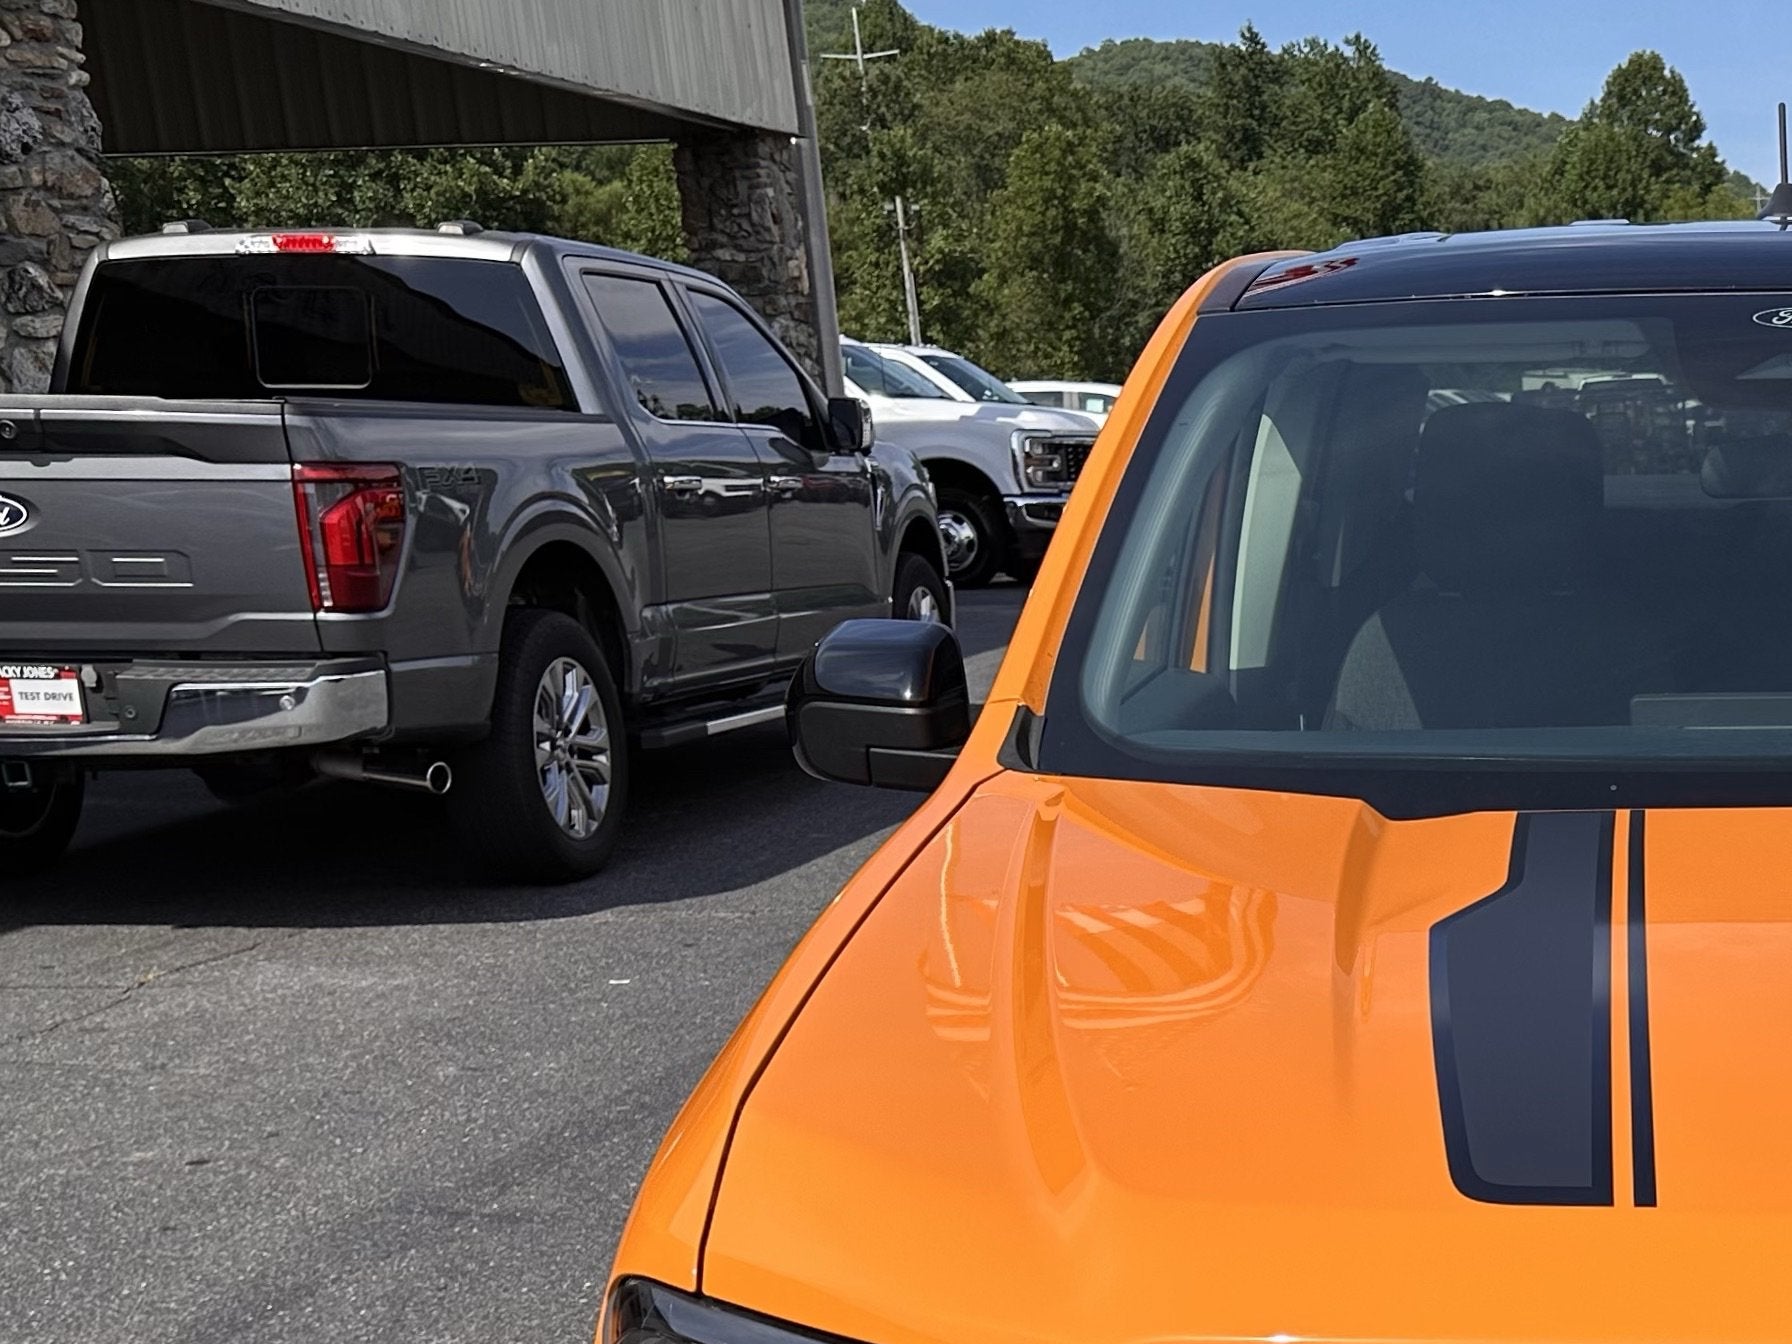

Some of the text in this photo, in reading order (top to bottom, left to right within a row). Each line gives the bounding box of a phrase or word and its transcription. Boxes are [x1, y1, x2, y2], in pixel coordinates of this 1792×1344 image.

[23, 665, 55, 679] JONES
[18, 691, 41, 701] TEST
[44, 691, 74, 702] DRIVE
